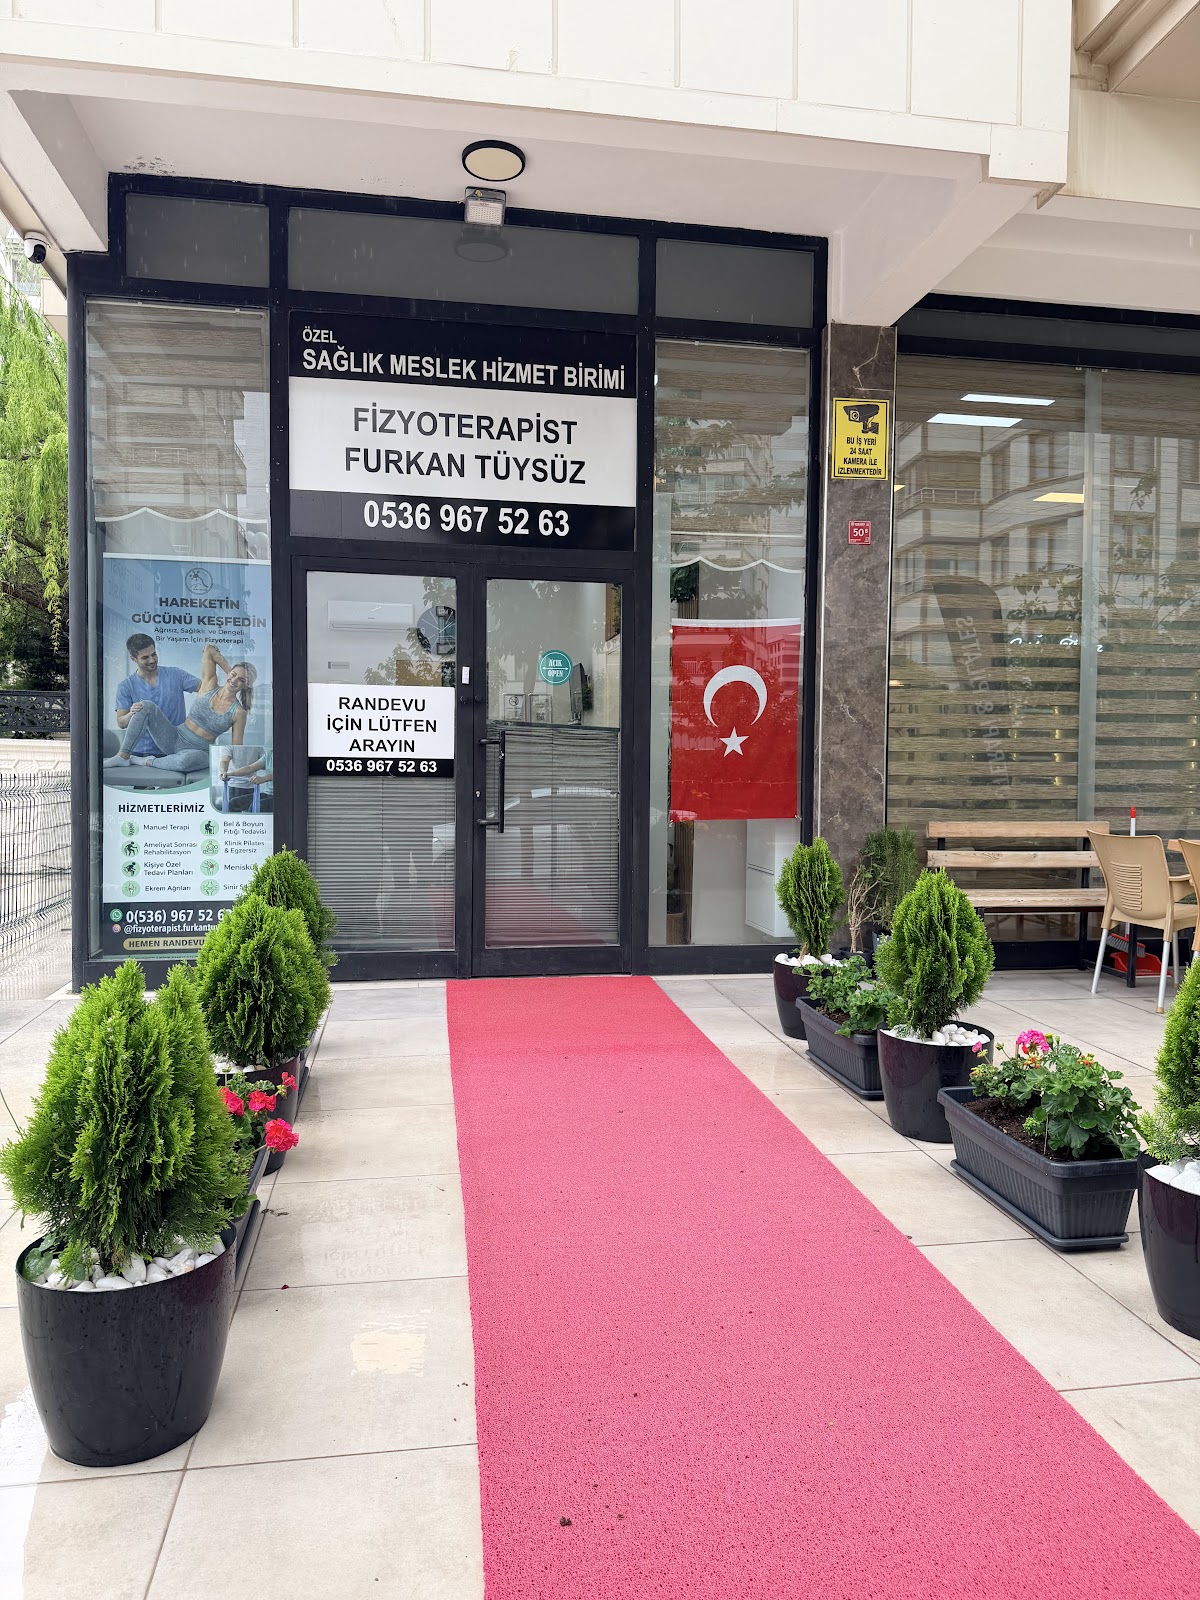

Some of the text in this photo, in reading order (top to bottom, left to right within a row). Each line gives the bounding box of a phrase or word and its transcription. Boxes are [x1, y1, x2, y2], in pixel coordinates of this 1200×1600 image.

[302, 325, 338, 344] ÖZEL
[302, 345, 626, 390] SAĞLIK MESLEK HİZMET BİRİMİ
[353, 402, 578, 445] FİZYOTERAPİST
[847, 436, 877, 447] BU İŞ YERİ
[858, 448, 872, 456] SAAT
[345, 447, 586, 485] FURKAN TÜYSÜZ
[844, 458, 877, 466] KAMERA İLE
[838, 467, 882, 476] İZLENMEKTEDİR
[363, 500, 570, 537] 0536 967 52 63
[159, 597, 240, 609] HAREKETİN
[131, 612, 267, 628] GÜCÜNÜ KEŞFEDİN
[218, 629, 245, 637] Dengeli
[166, 635, 189, 643] Yaşam
[190, 635, 203, 643] İçin
[204, 637, 244, 645] Fizyoterapi
[548, 659, 563, 667] AÇIK
[547, 669, 563, 677] OPEN
[338, 696, 426, 711] RANDEVU
[326, 714, 437, 734] İÇİN LÜTFEN
[349, 738, 415, 753] ARAYIN
[326, 759, 438, 773] 0536 967 52 63
[118, 802, 205, 813] HİZMETLERİMİZ
[143, 860, 181, 869] Kişiye Özel
[223, 883, 239, 891] Sinir
[126, 909, 167, 924] 0(536)
[170, 909, 194, 922] 967
[198, 909, 213, 921] 52
[128, 939, 205, 948] HEMEN RANDEVU
